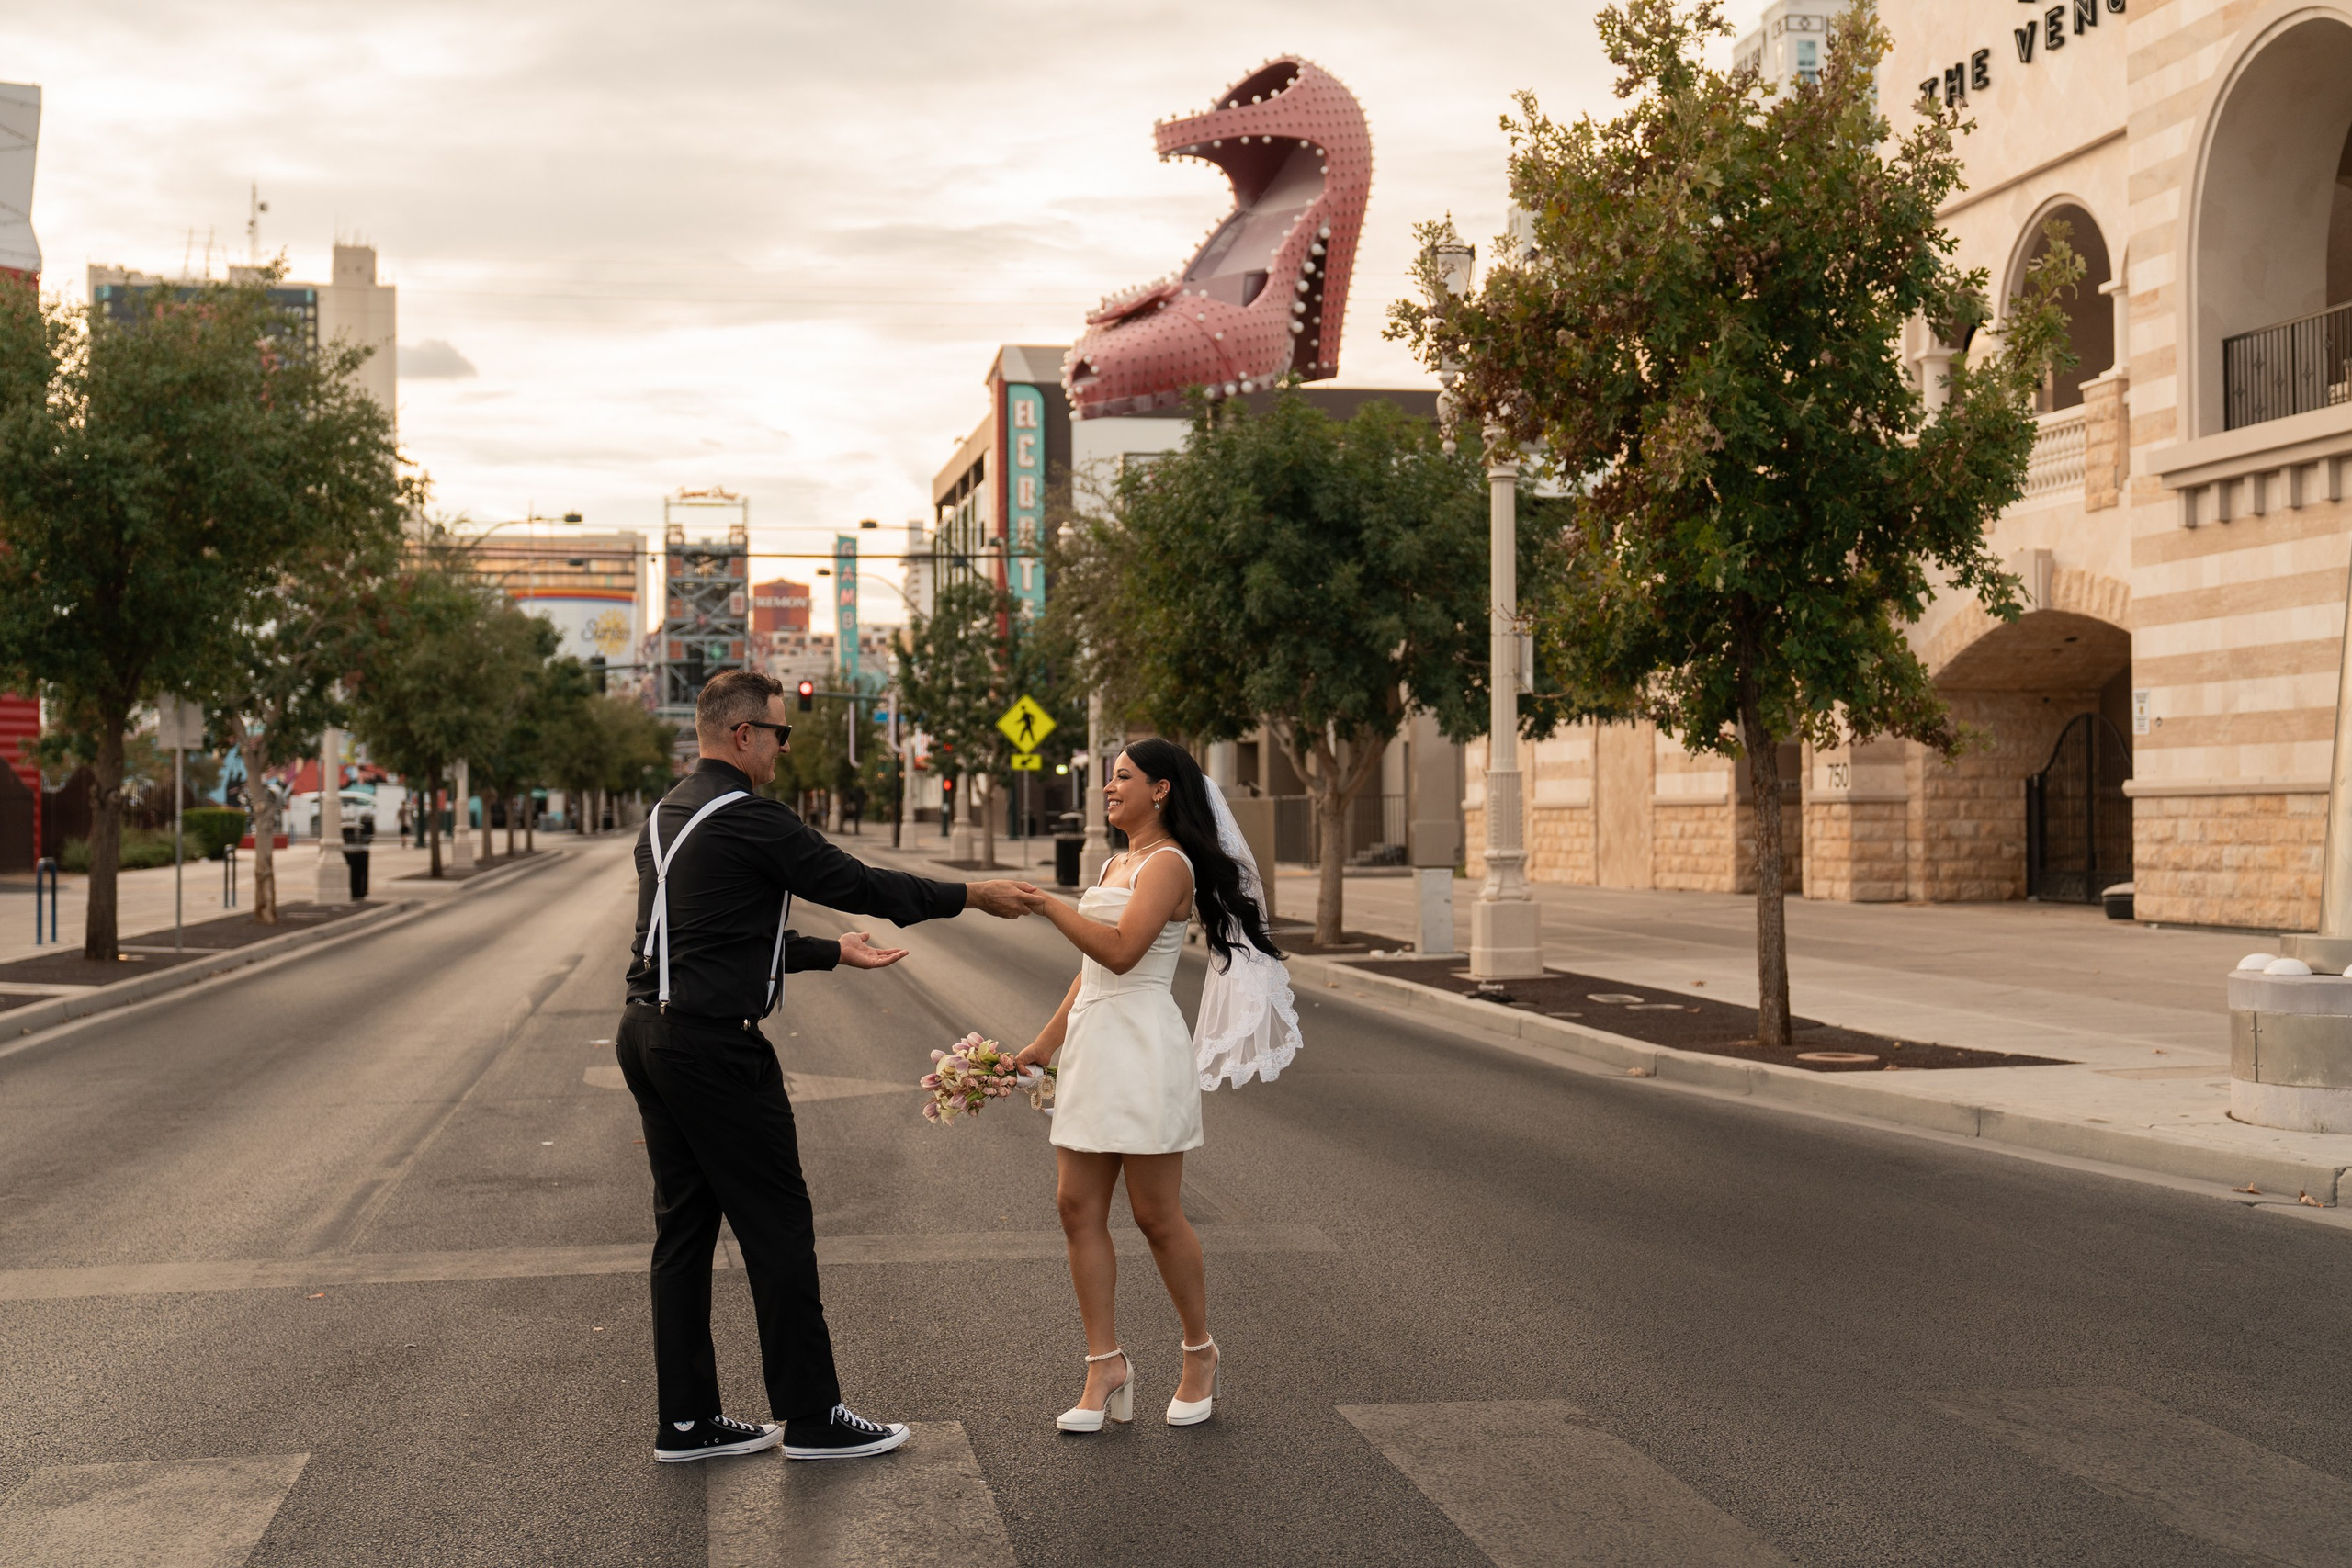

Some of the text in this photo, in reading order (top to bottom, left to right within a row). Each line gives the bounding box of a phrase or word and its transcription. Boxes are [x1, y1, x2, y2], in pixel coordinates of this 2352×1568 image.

[1919, 49, 1990, 108] THE
[1014, 400, 1037, 428] EL
[1017, 434, 1036, 632] CORTE
[840, 541, 856, 691] GAMBLI
[1827, 763, 1849, 787] 750
